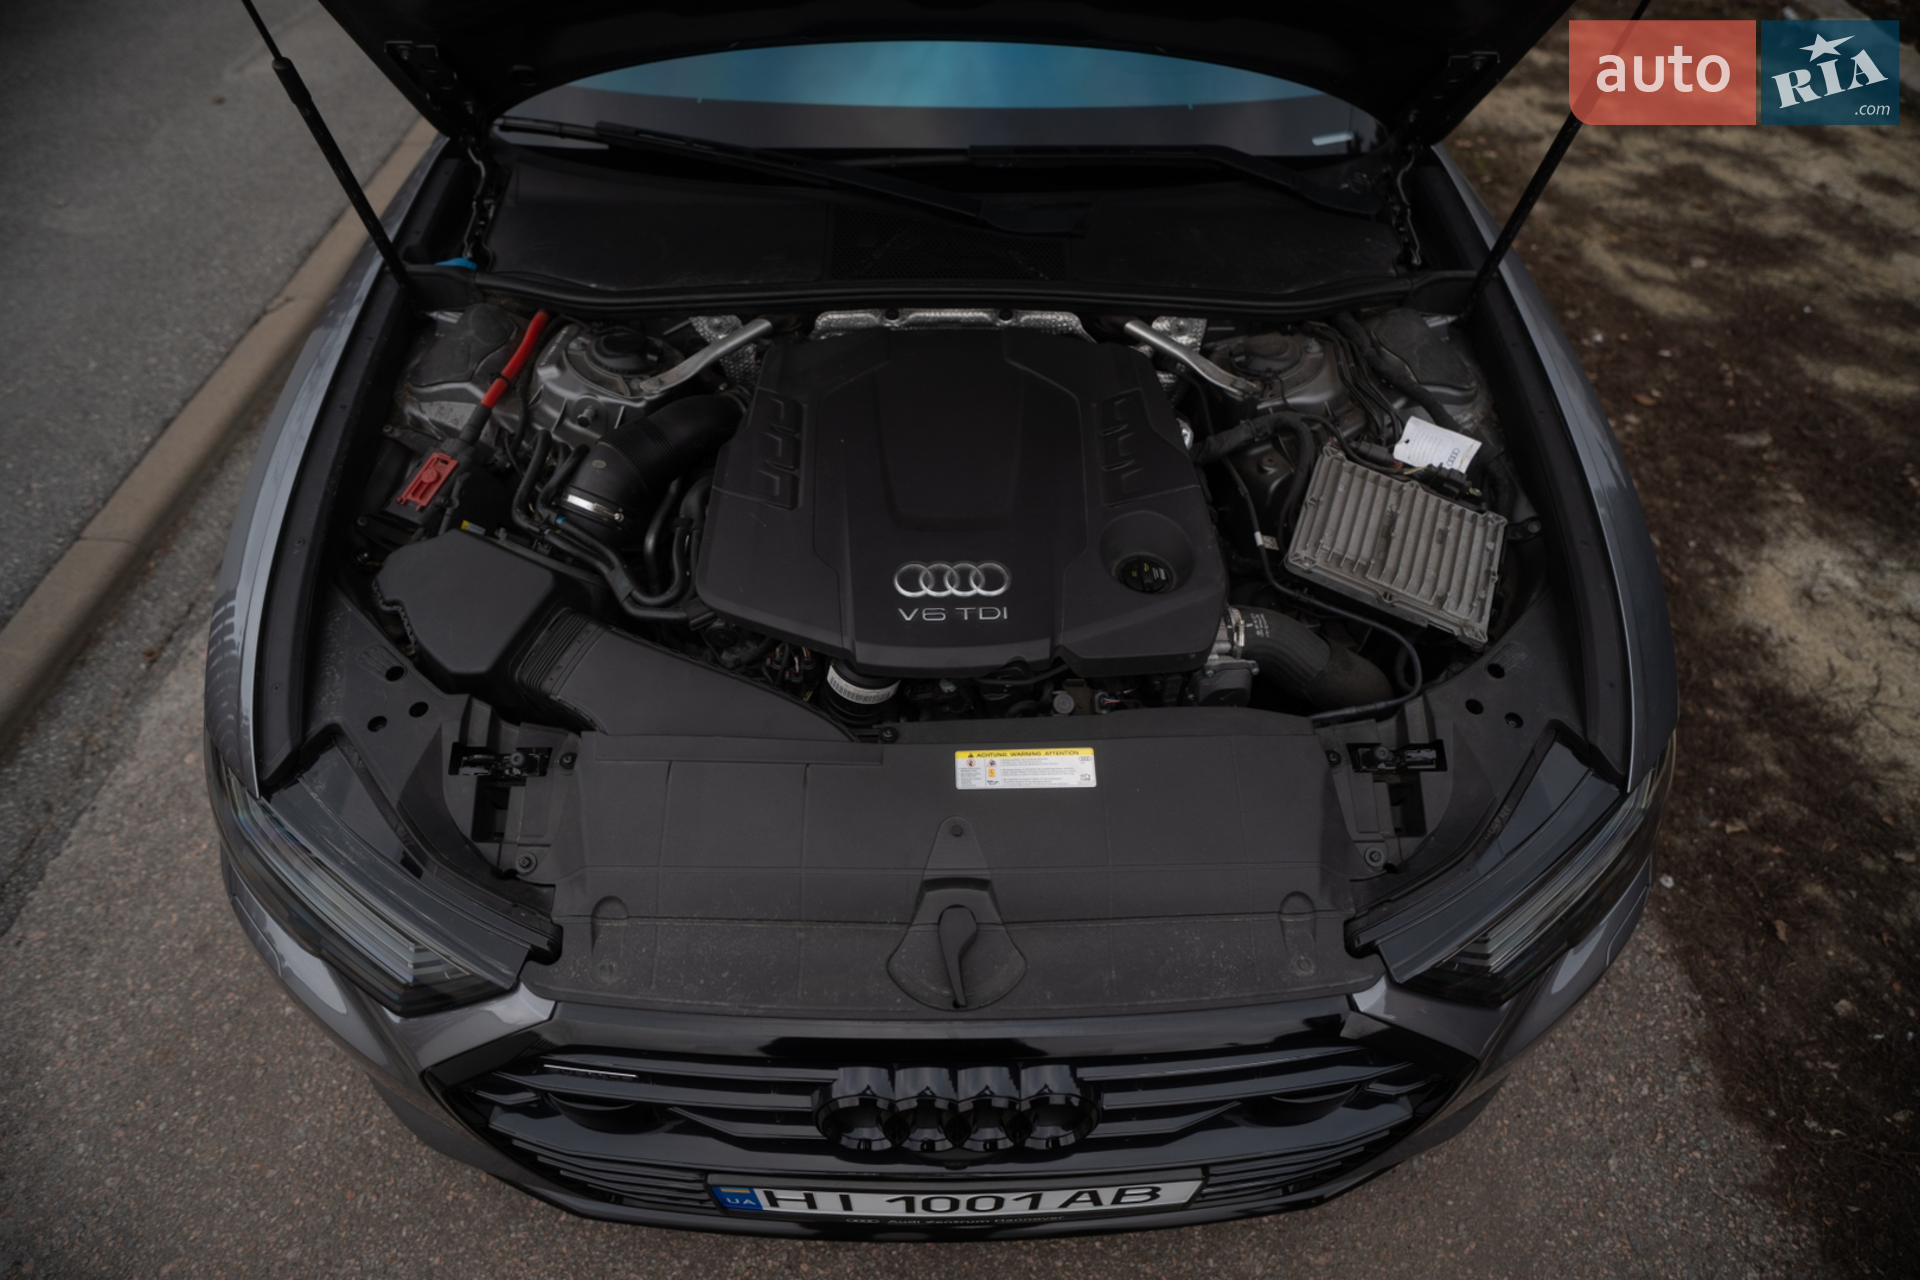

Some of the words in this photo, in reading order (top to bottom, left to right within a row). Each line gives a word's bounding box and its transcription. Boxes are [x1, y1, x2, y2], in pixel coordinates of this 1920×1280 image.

[898, 607, 947, 621] V6
[955, 606, 1008, 621] TDI
[726, 1197, 757, 1206] UA
[763, 1189, 853, 1212] HI
[885, 1192, 1043, 1214] 1001
[1058, 1186, 1162, 1208] AB
[995, 1215, 1065, 1223] Hannover
